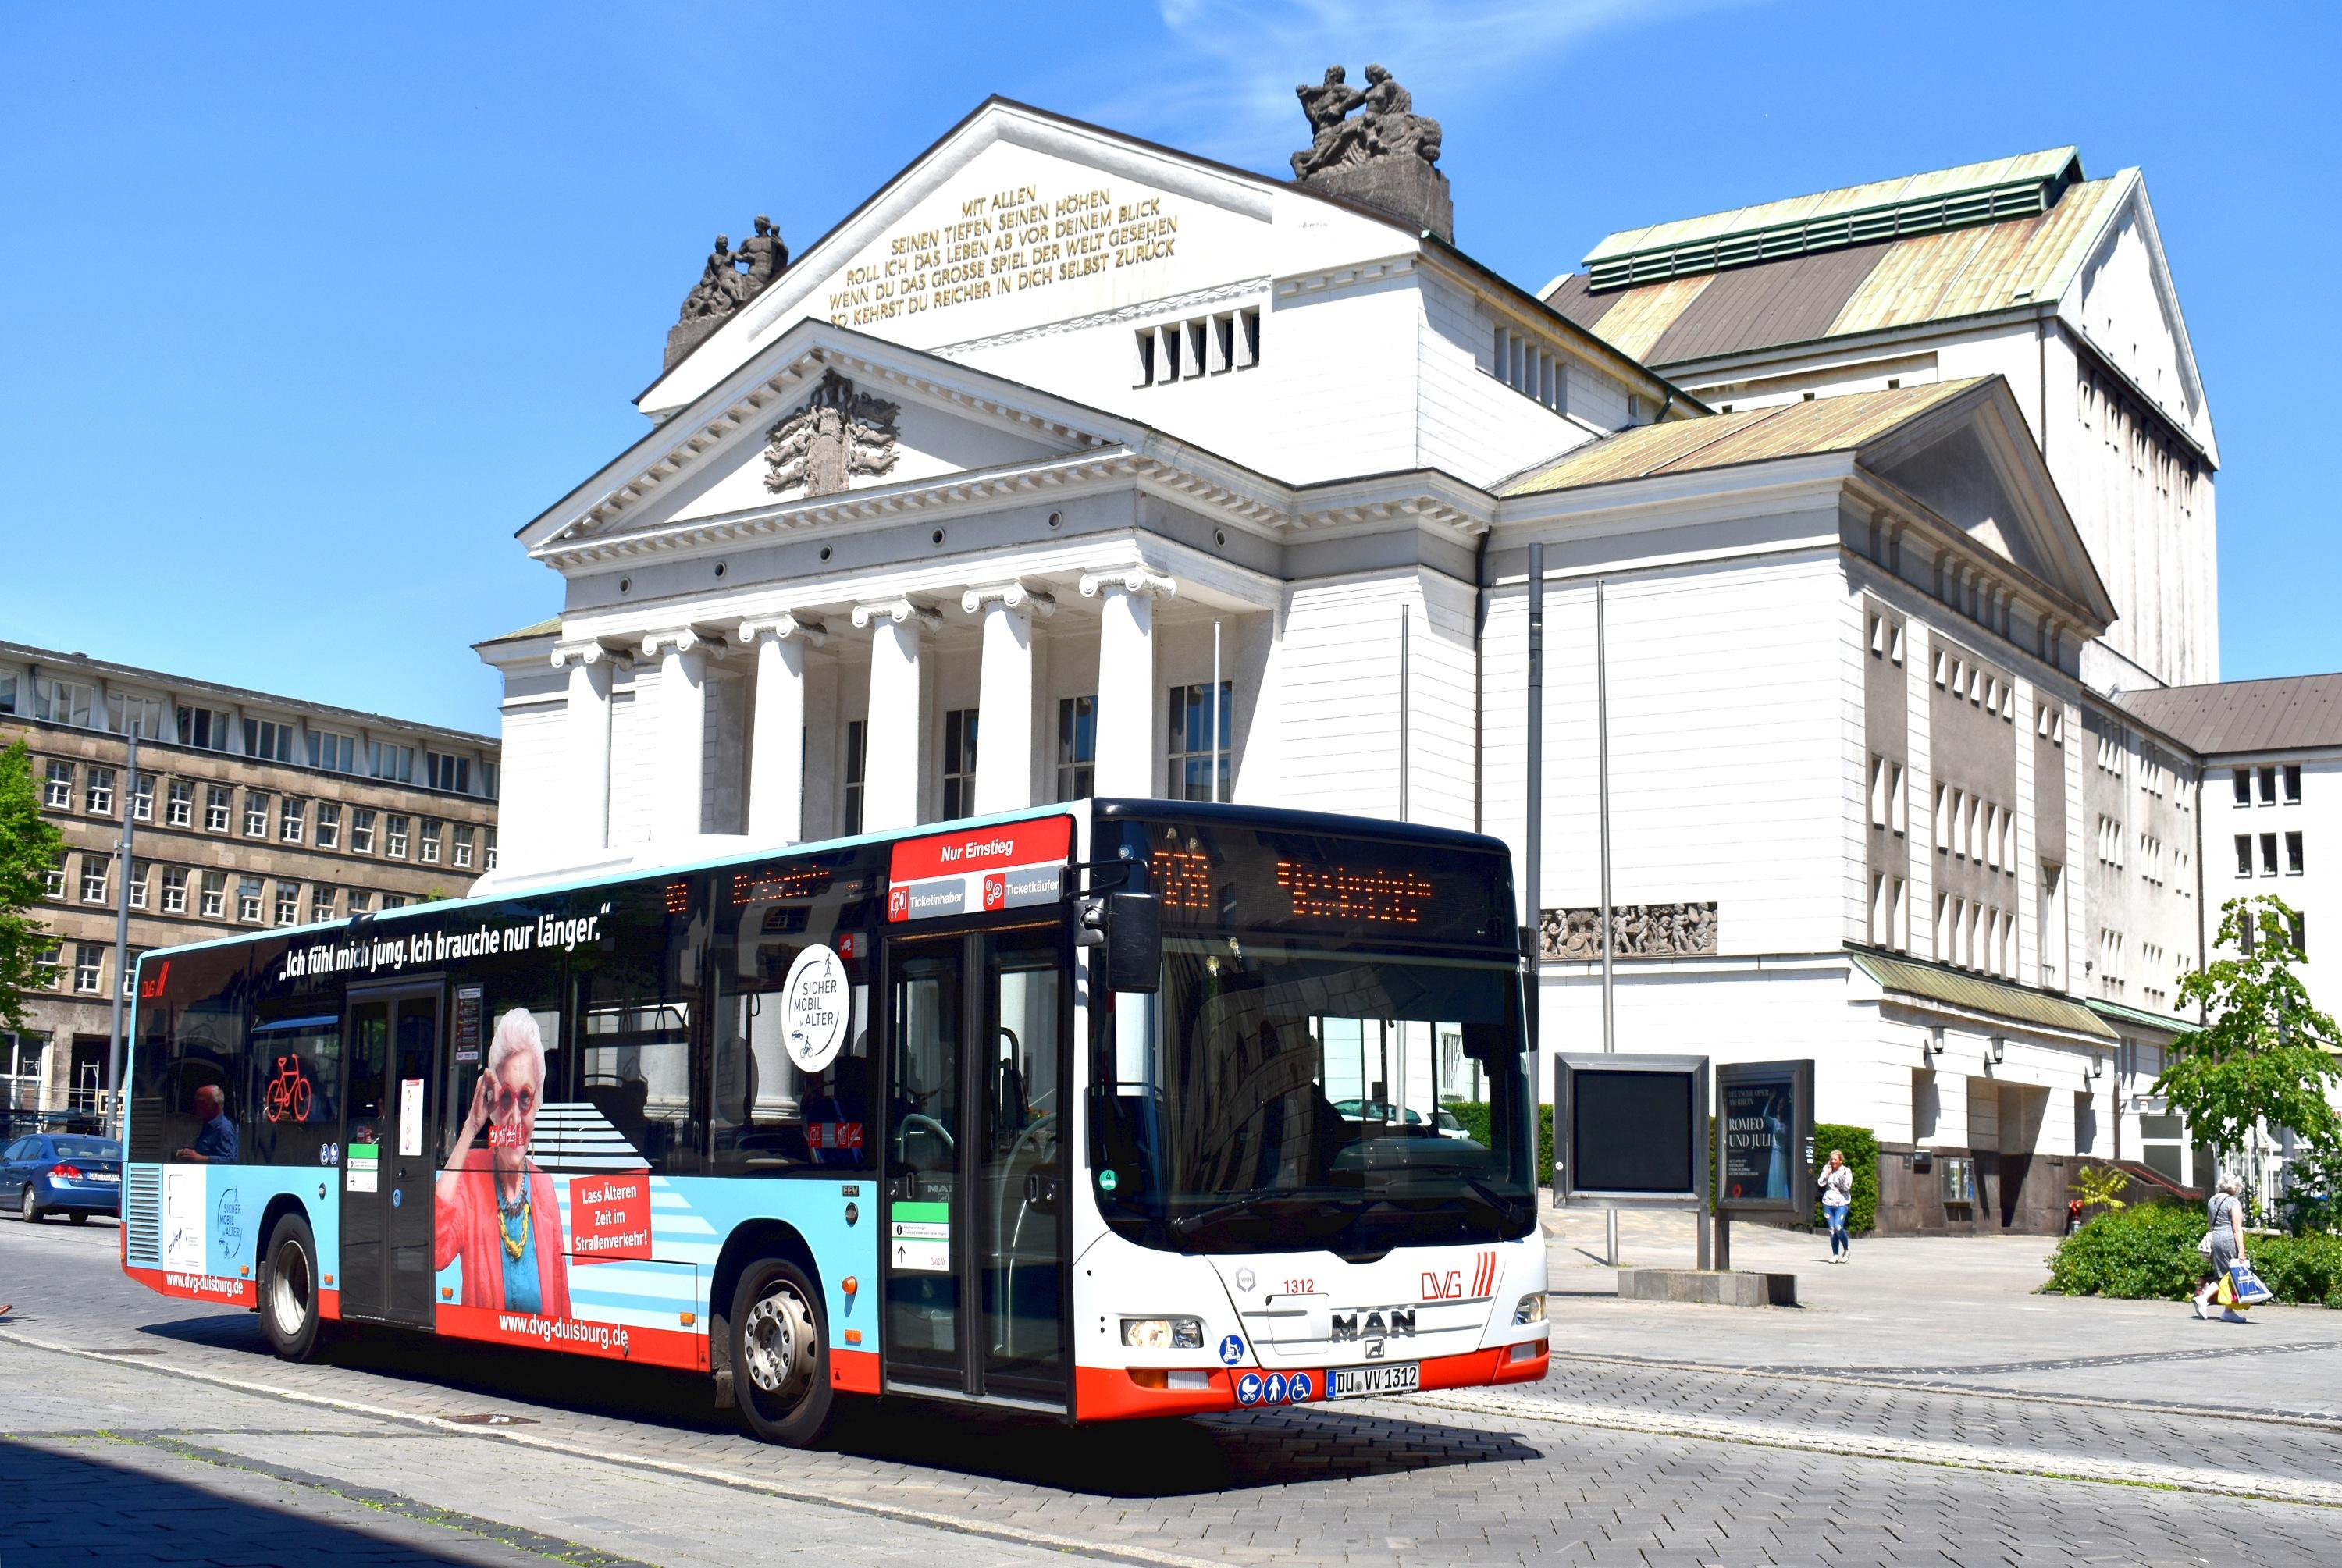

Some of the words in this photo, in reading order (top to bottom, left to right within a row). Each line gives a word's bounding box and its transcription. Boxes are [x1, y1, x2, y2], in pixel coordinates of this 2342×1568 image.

[962, 197, 987, 219] MIT
[992, 184, 1037, 212] ALLEN
[892, 229, 940, 256] SEINEN
[944, 216, 992, 244] TIEFEN
[998, 203, 1048, 231] SEINEN
[1055, 188, 1110, 217] HÖHEN
[846, 265, 880, 287] ROLL
[885, 257, 908, 279] ICH
[914, 250, 941, 272] DAS
[947, 238, 989, 264] LEBEN
[994, 233, 1013, 254] AB
[1018, 224, 1048, 247] VOR
[1055, 209, 1112, 239] DEINEM
[1119, 197, 1161, 224] BLICK
[829, 286, 869, 311] WENN
[875, 278, 895, 300] DU
[900, 273, 926, 294] DAS
[931, 260, 985, 288] GROSSE
[991, 251, 1028, 275] SPIEL
[1033, 243, 1060, 265] DER
[1066, 233, 1105, 258] WELT
[1109, 215, 1178, 247] GESEHEN
[831, 311, 849, 328] SO
[853, 299, 905, 326] KEHRST
[908, 293, 928, 314] DU
[934, 280, 991, 309] REICHER
[997, 276, 1011, 295] IN
[1018, 266, 1052, 290] DICH
[1059, 253, 1109, 280] SELBST
[1115, 236, 1176, 268] ZURÜCK
[941, 845, 963, 862] Nur
[965, 839, 1013, 859] Einstieg
[1005, 879, 1060, 896] Ticketkäufer
[909, 891, 963, 908] Ticketinhaber
[308, 943, 335, 975] fühl
[336, 939, 370, 971] mich
[370, 937, 408, 973] jung.
[410, 932, 432, 964] Ich
[436, 924, 500, 960] brauche
[503, 925, 535, 952] nur
[142, 980, 155, 998] DVG
[803, 979, 838, 996] SICHER
[793, 997, 823, 1012] MOBIL
[805, 1012, 835, 1027] ALTER
[1728, 1117, 1764, 1131] ROMEO
[1728, 1133, 1749, 1147] UND
[1105, 1170, 1112, 1180] 4
[582, 1188, 603, 1204] Lass
[603, 1181, 637, 1202] Älteren
[223, 1204, 241, 1214] SICHER
[594, 1209, 612, 1226] Zeit
[614, 1208, 625, 1225] im
[219, 1214, 234, 1225] MOBIL
[226, 1226, 240, 1237] ALTER
[575, 1228, 648, 1252] Straßenverkehr!
[166, 1272, 244, 1298] www.dvg-duisburg.de
[1283, 1278, 1314, 1294] 1312
[1421, 1271, 1461, 1300] DVG
[498, 1314, 629, 1349] www.dvg-duisburg.de
[1331, 1309, 1416, 1342] MAN
[1336, 1372, 1354, 1393] DU
